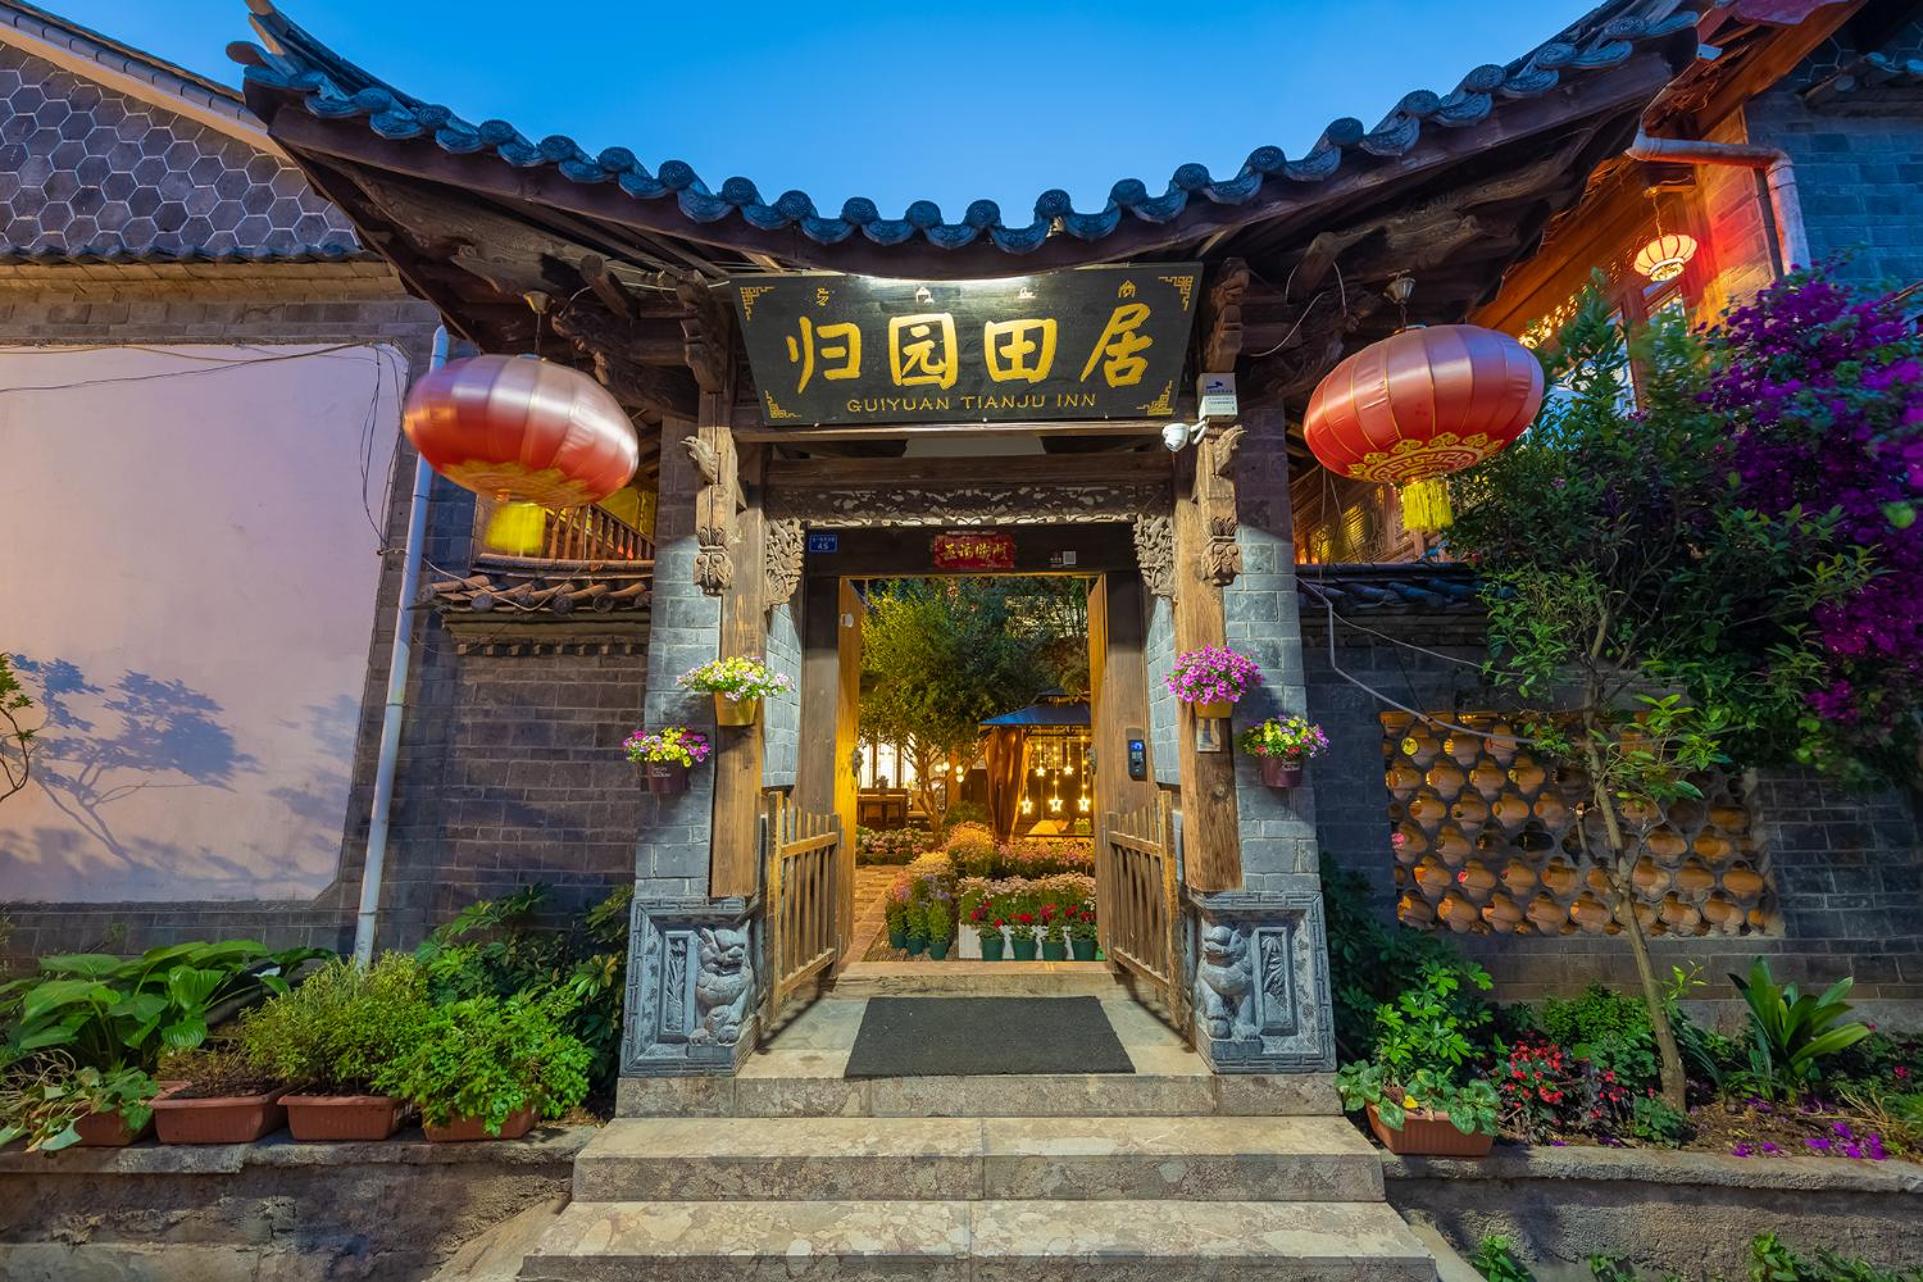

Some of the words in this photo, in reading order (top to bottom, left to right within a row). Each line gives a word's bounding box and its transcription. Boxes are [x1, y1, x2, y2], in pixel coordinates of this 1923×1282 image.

[786, 303, 1153, 394] 归园田居
[847, 397, 949, 413] GUIYUAN
[961, 394, 1045, 409] TIANJU
[1056, 393, 1096, 407] INN
